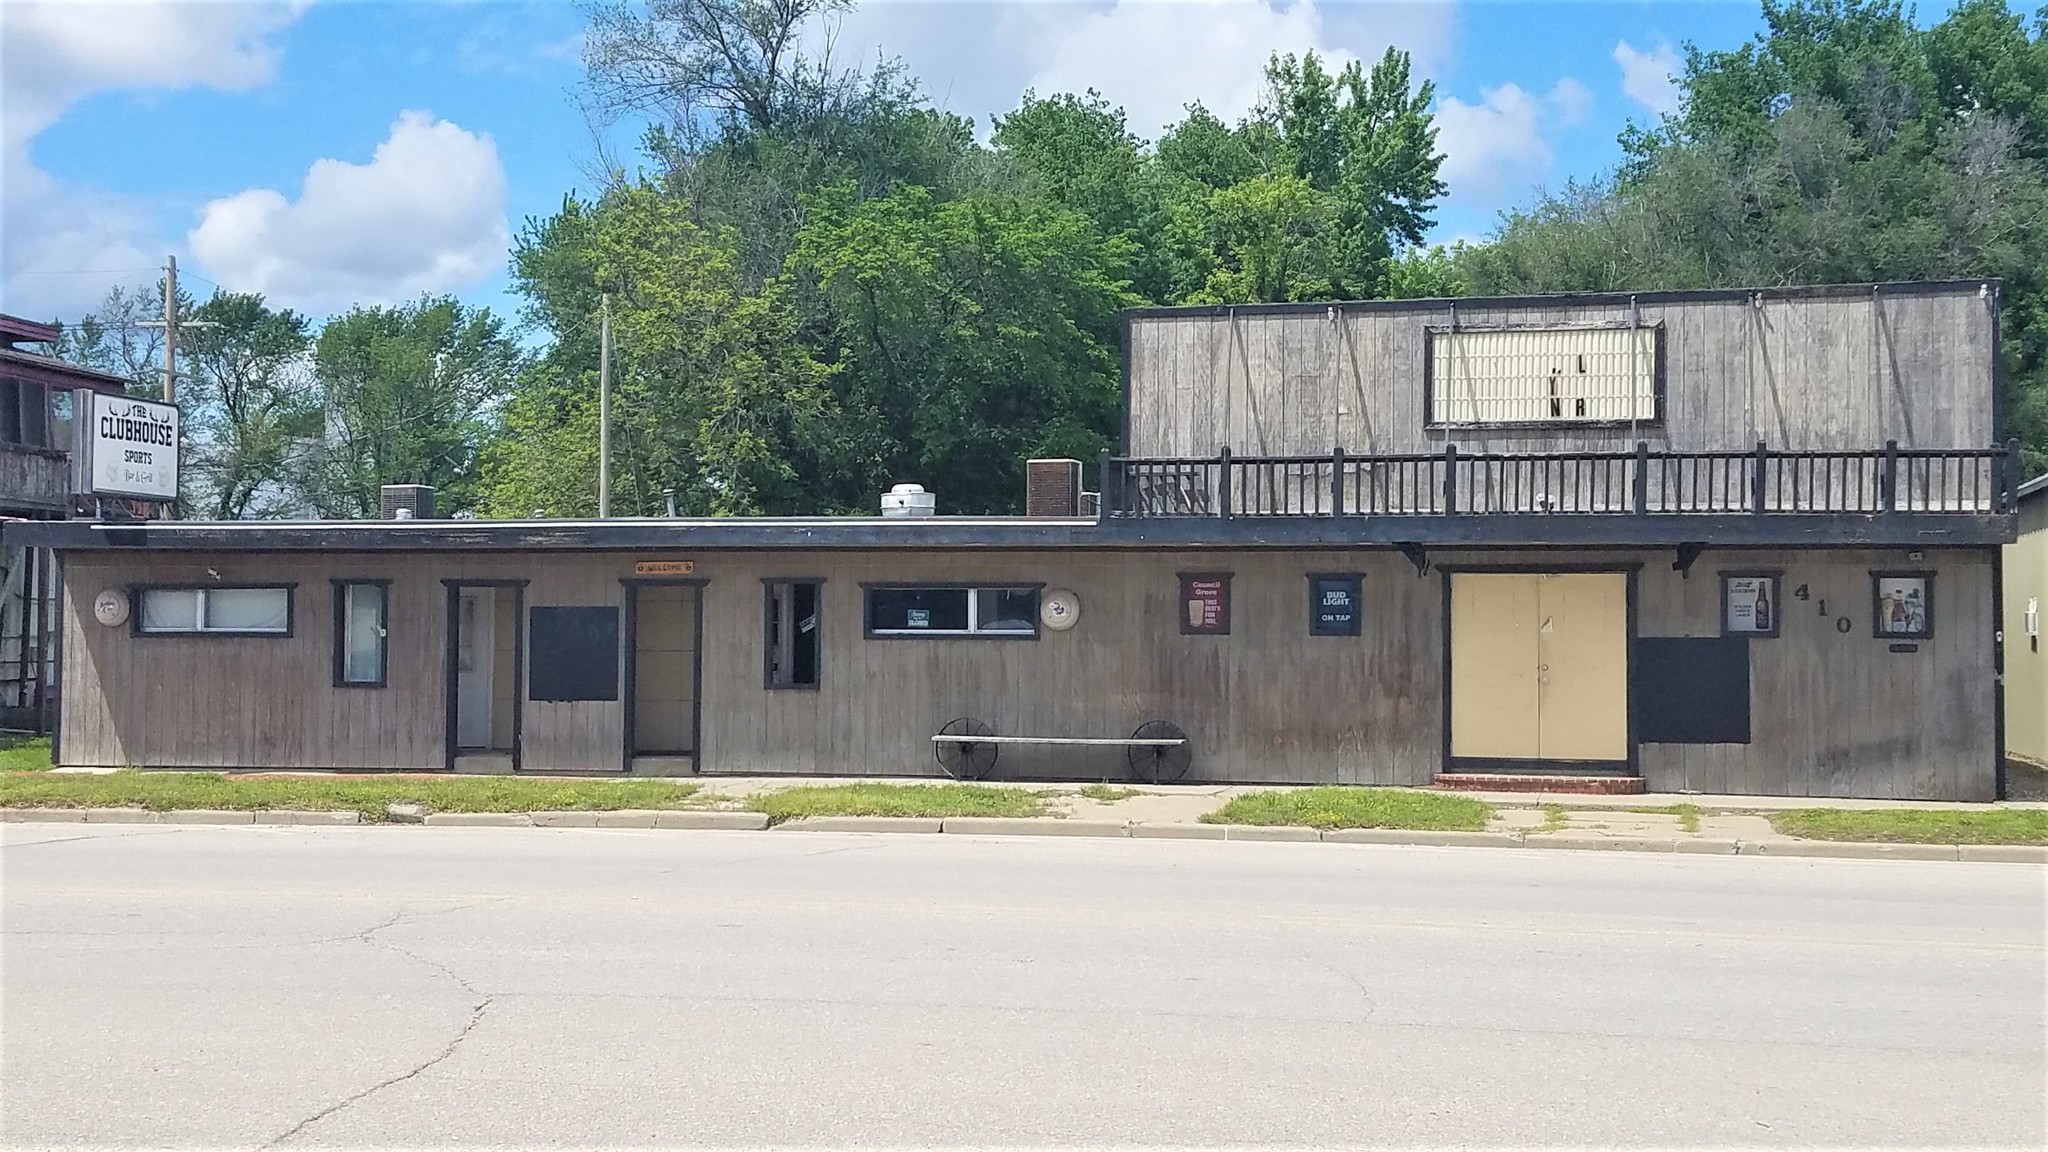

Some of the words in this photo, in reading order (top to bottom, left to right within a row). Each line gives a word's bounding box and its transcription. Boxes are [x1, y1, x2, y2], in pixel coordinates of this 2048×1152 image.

[132, 405, 147, 418] THE
[1550, 397, 1561, 417] N
[101, 416, 173, 447] CLUBHOUSE
[124, 449, 153, 465] SPORTS
